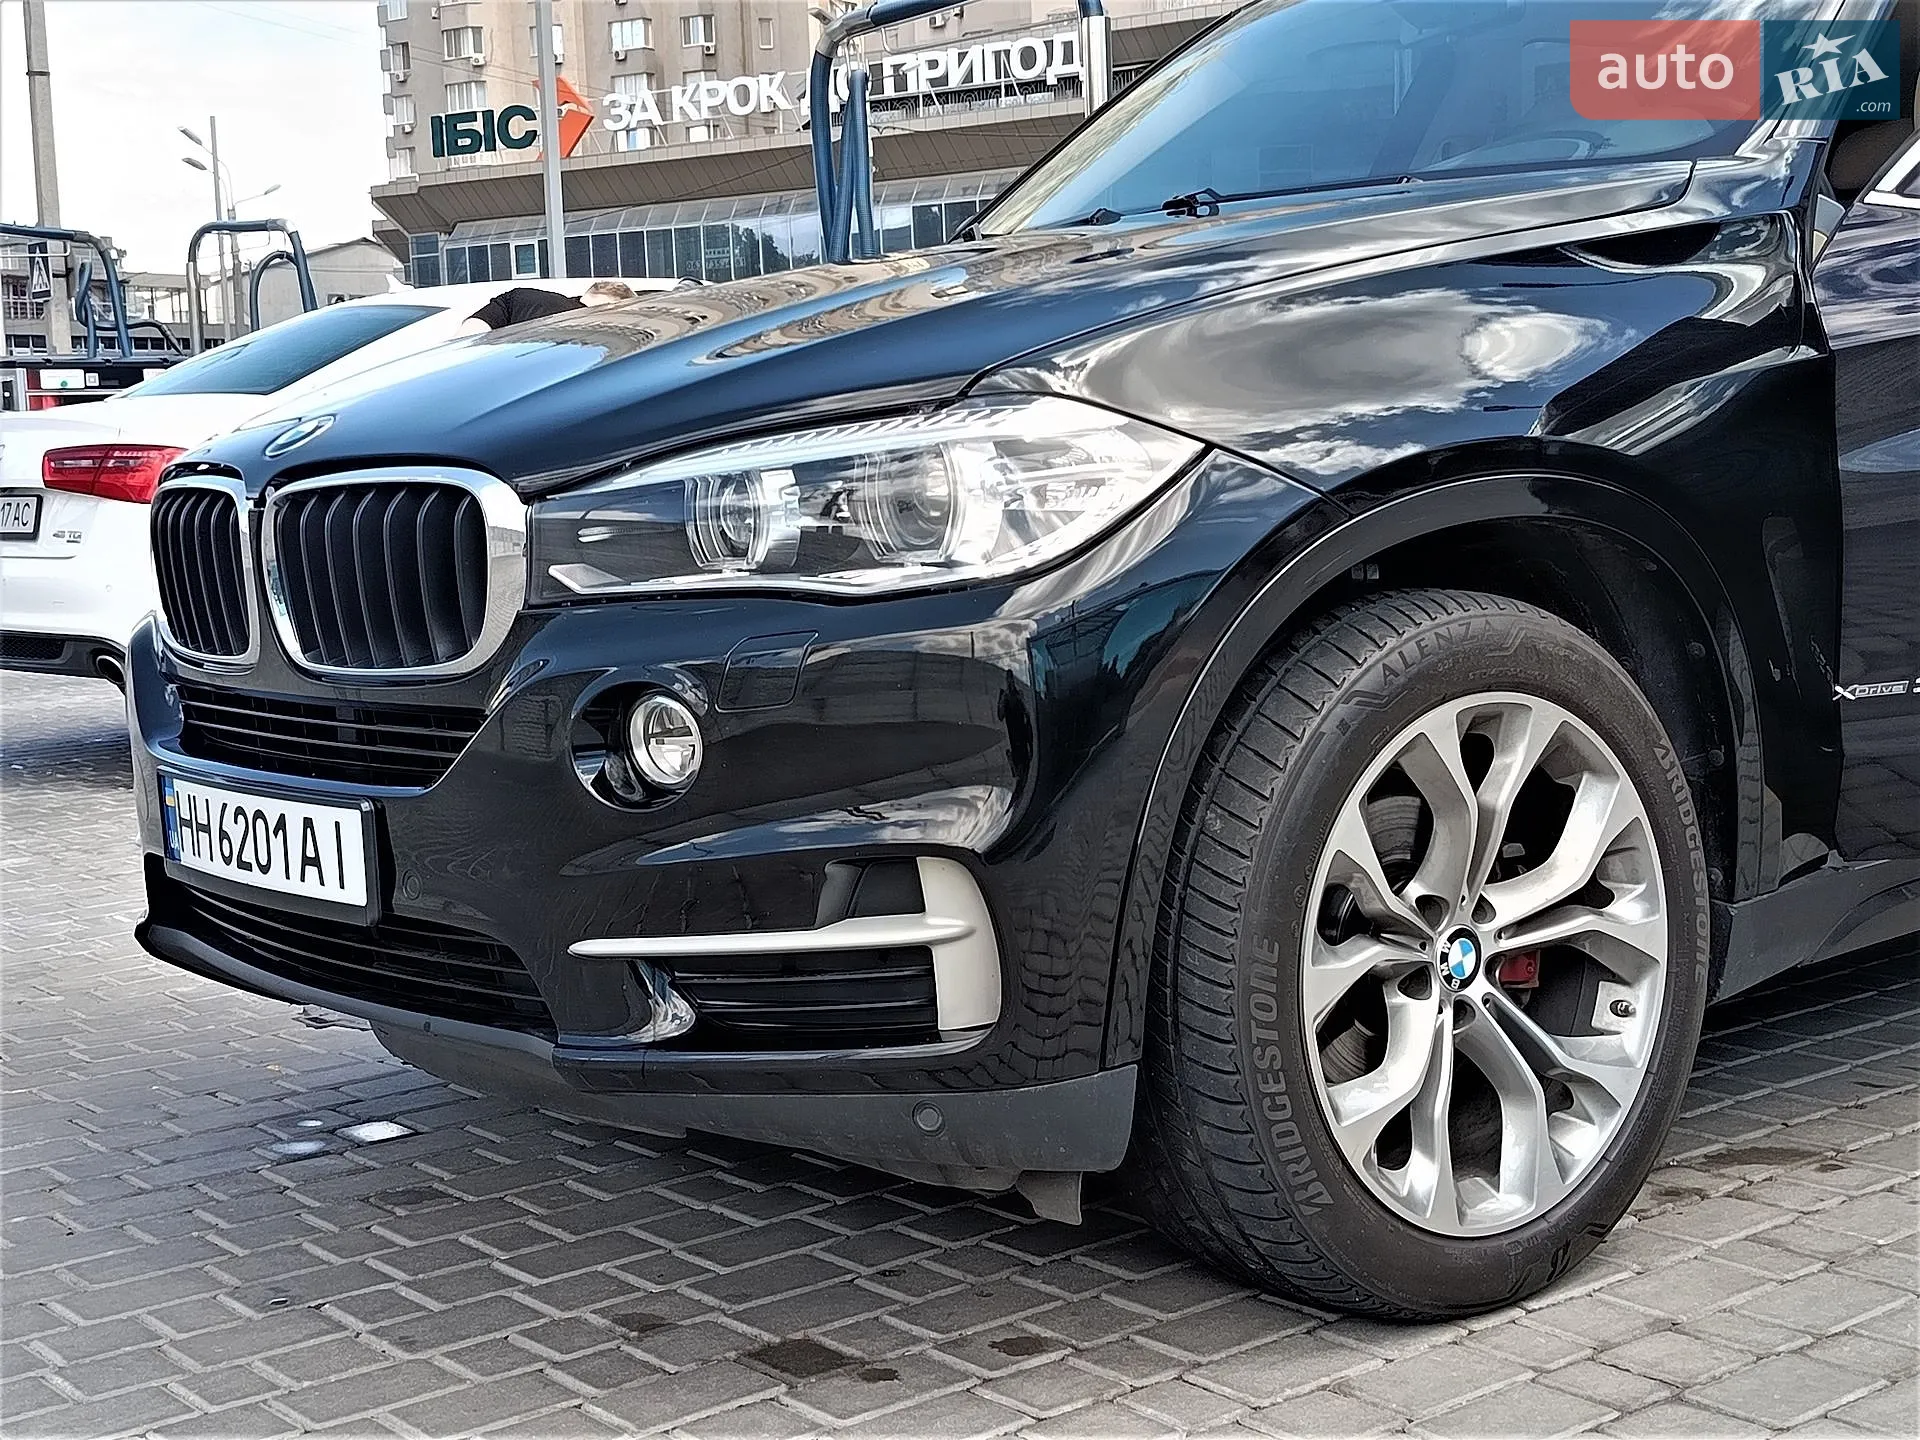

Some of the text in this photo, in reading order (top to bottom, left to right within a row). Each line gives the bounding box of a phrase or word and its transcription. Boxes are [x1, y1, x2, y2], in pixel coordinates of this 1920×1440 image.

[603, 89, 664, 131] ЗА
[671, 71, 792, 121] КРОК
[882, 31, 1085, 98] ПРИГОД
[431, 104, 538, 157] ІБІС
[1381, 620, 1500, 687] ALENZA
[1652, 737, 1709, 983] BRIDGESTONE
[1440, 941, 1460, 989] BMW
[1250, 933, 1335, 1216] BRIDGESTONE
